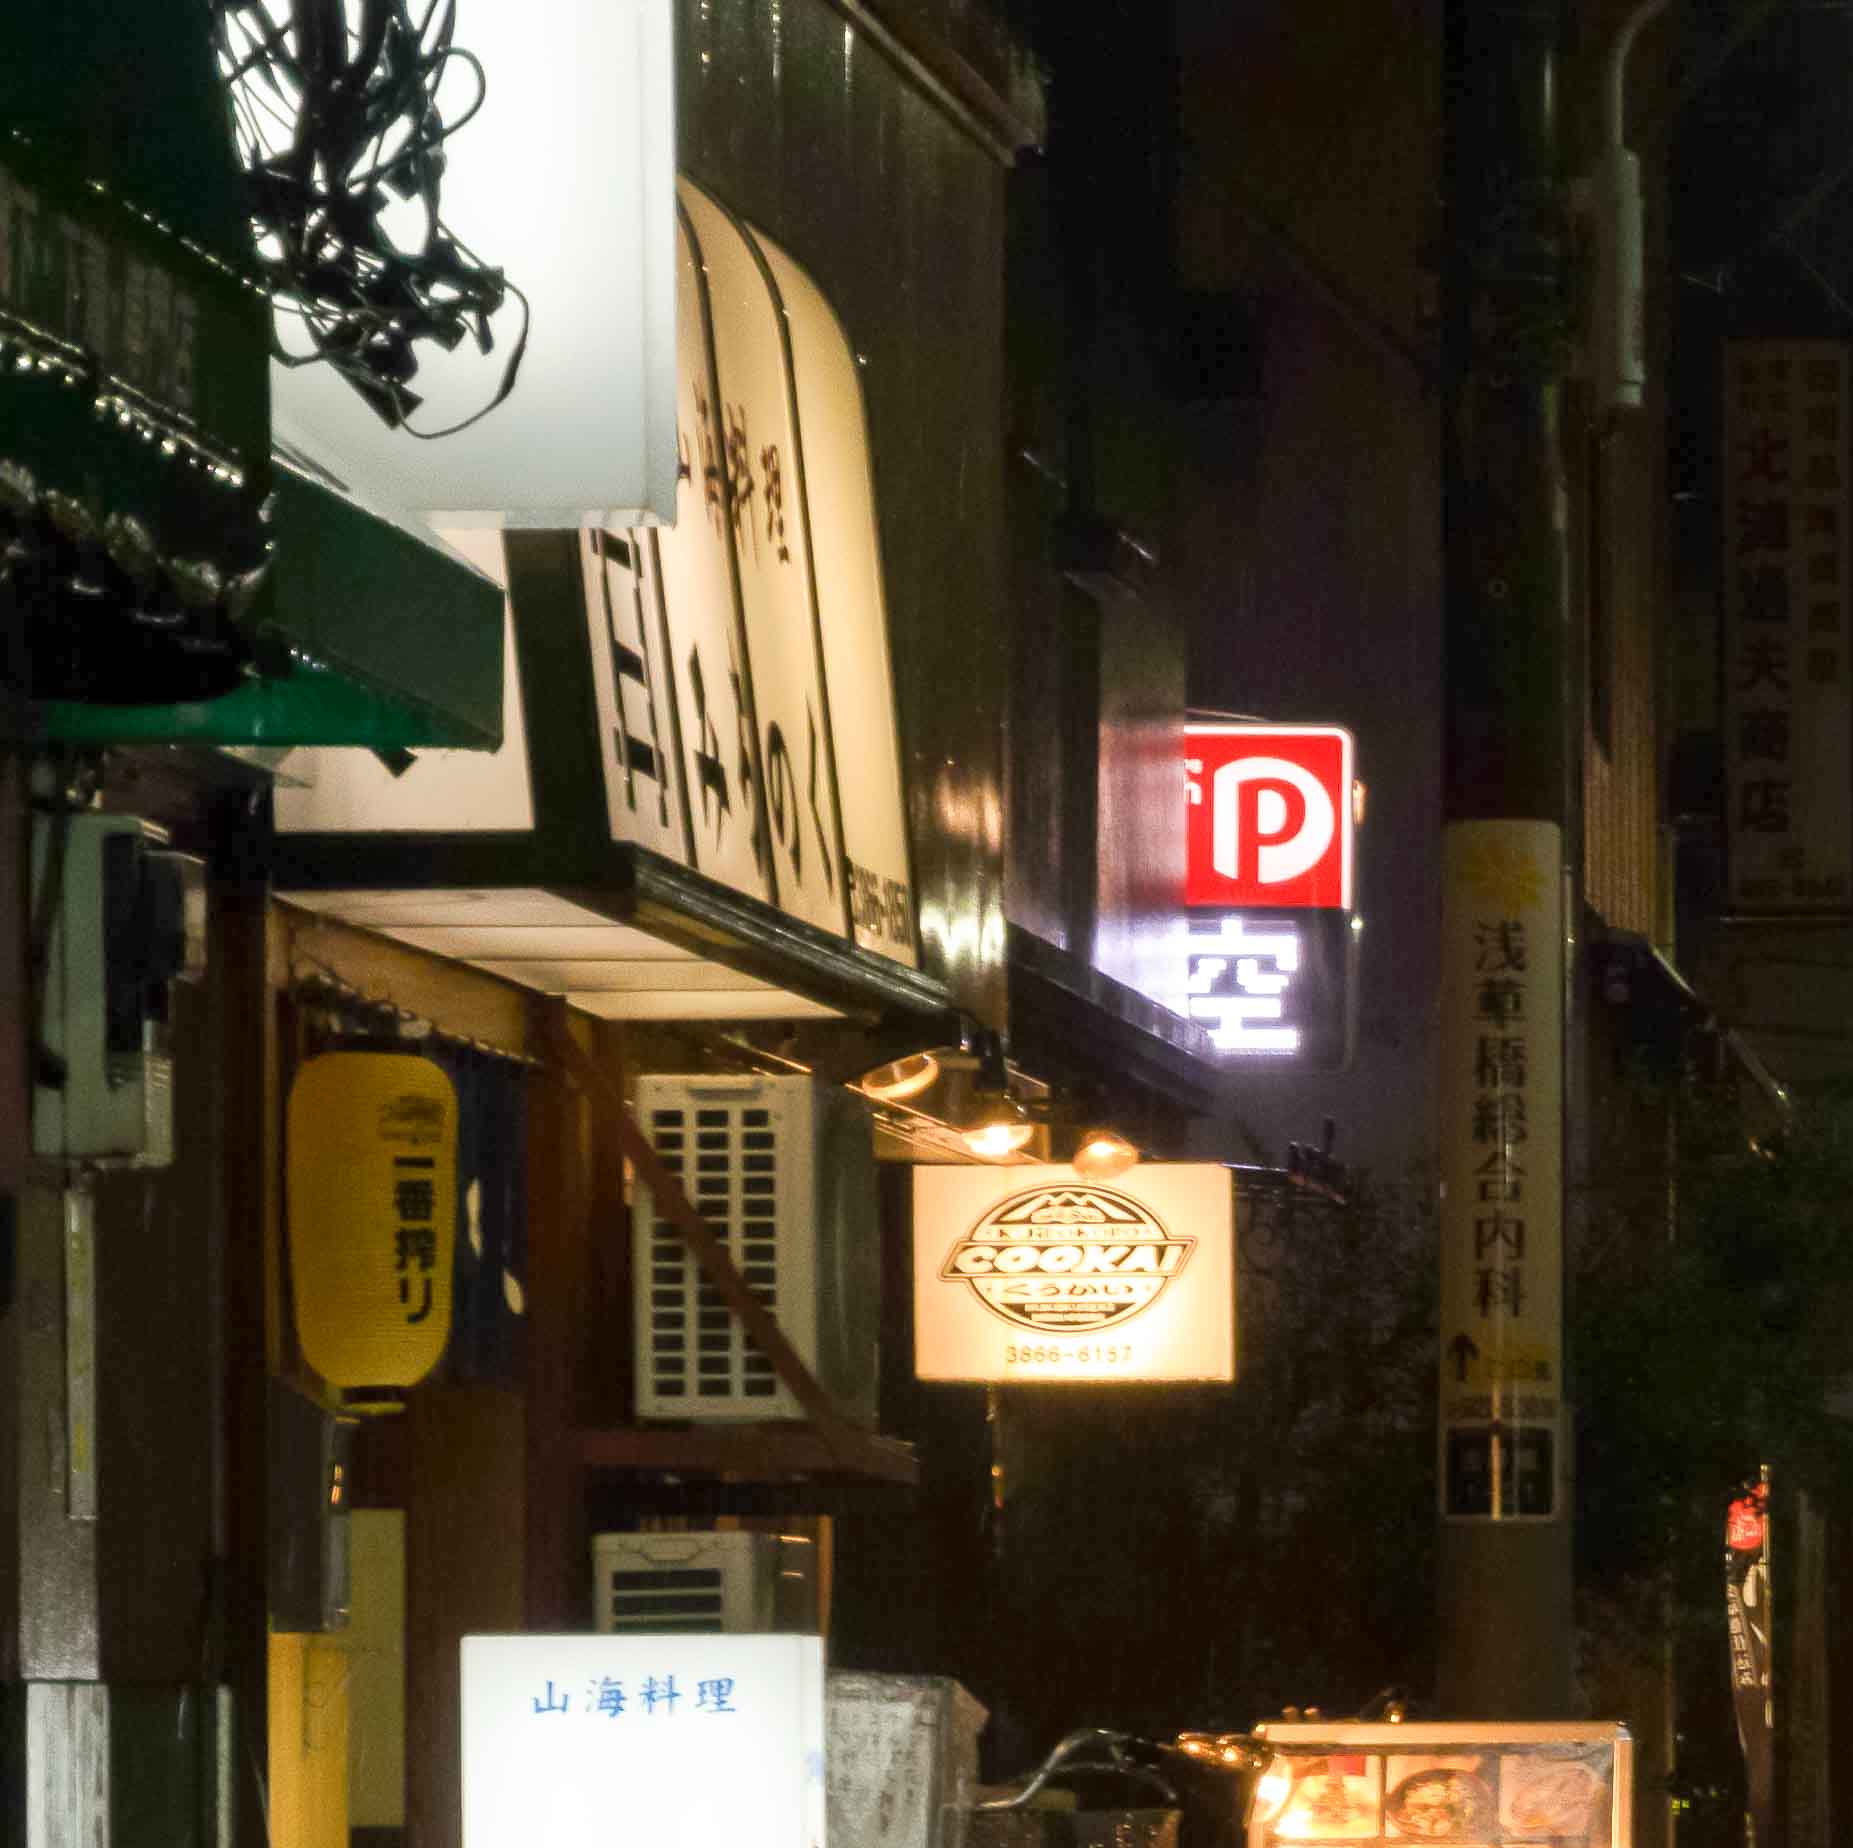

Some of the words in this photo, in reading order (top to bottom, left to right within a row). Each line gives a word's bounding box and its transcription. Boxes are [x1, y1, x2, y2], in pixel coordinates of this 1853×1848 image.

[1472, 918, 1528, 1318] 浅草橋総合内科
[953, 1244, 1185, 1273] COOKAI
[533, 1674, 737, 1719] 山海料理
